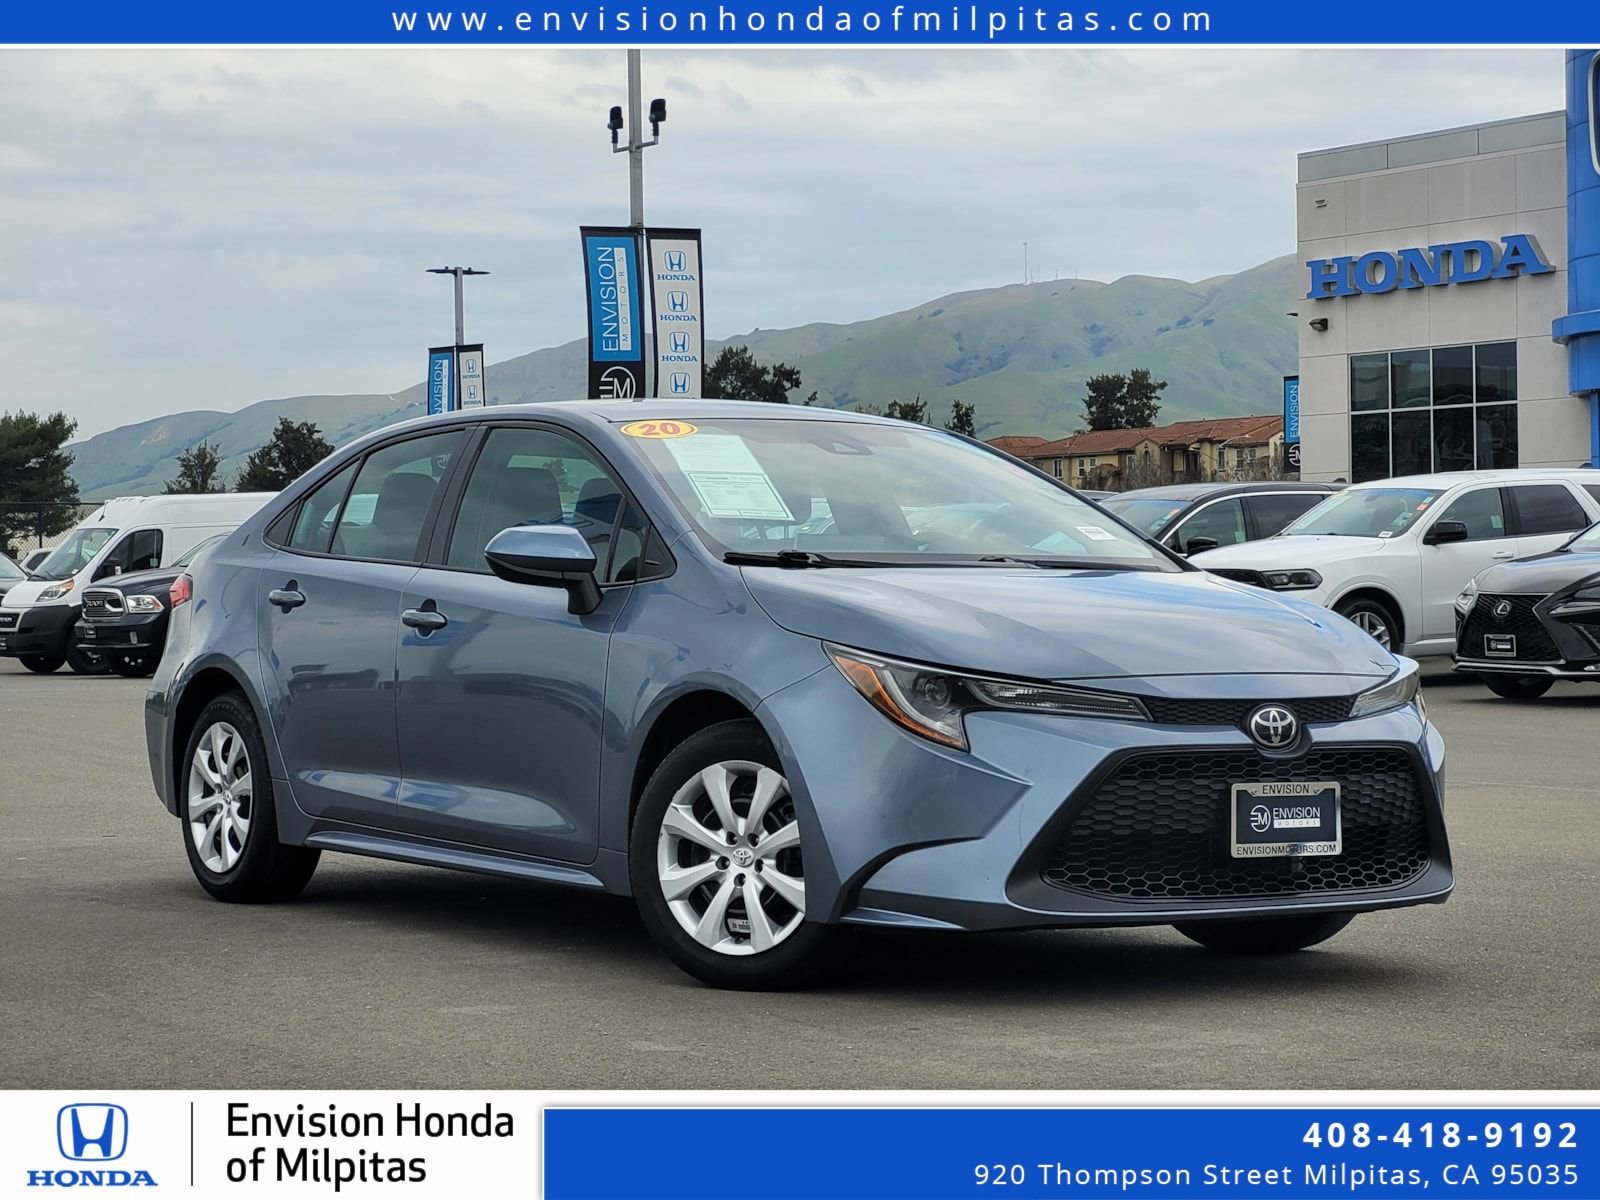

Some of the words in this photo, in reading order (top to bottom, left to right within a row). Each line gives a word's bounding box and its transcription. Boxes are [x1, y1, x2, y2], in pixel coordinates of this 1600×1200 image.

[1306, 234, 1551, 300] HONDA
[656, 274, 696, 282] HONDA
[597, 246, 619, 352] ENVISION
[617, 256, 630, 342] MOTORS
[660, 314, 698, 322] HONDA
[661, 355, 699, 363] HONDA
[433, 360, 443, 415] NVISION
[1289, 384, 1299, 438] ENVISION
[638, 422, 681, 436] 20
[1262, 784, 1310, 795] ENVISION
[1273, 806, 1320, 820] ENVISION
[1236, 844, 1337, 856] ENVISIONMOORS.COM
